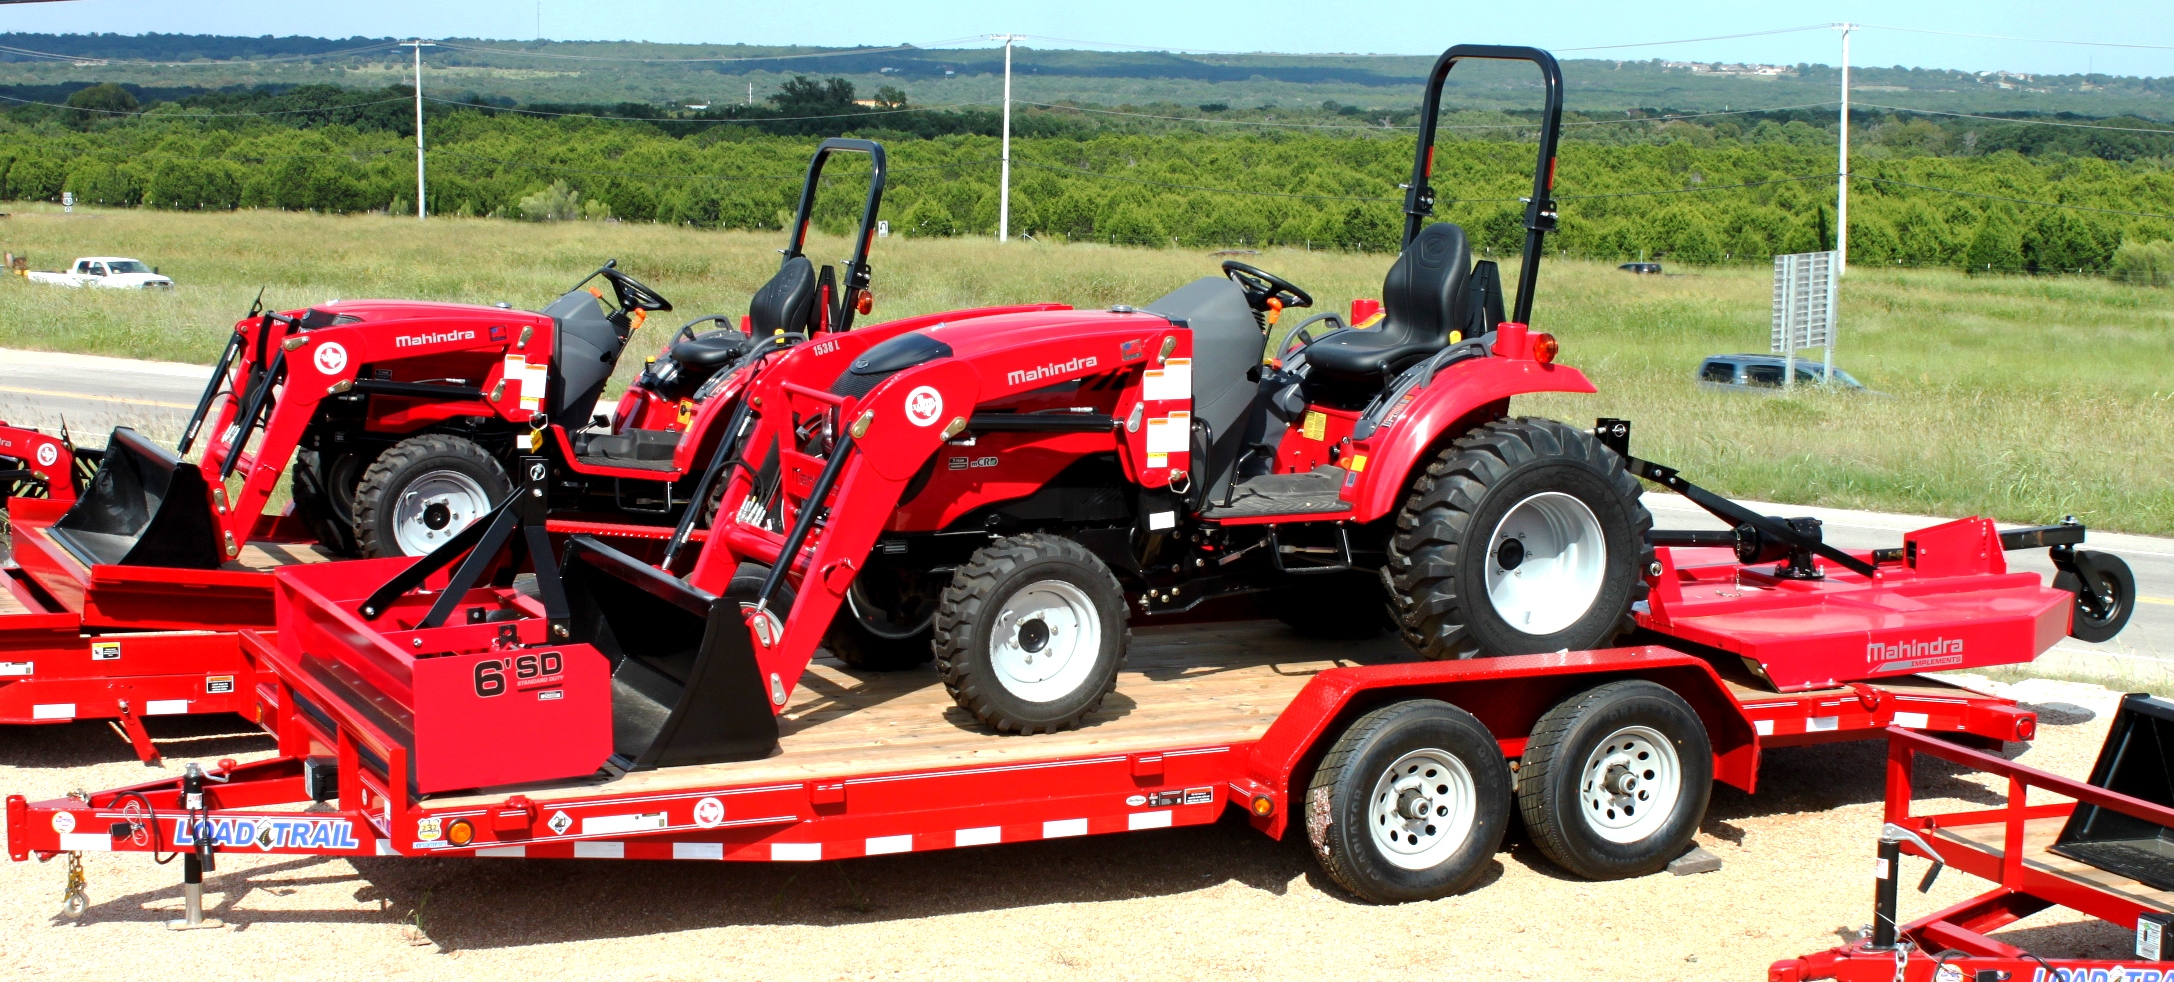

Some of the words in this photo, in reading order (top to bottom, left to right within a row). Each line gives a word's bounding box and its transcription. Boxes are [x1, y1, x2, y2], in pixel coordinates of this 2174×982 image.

[395, 329, 475, 348] Mahindra
[813, 341, 834, 357] 1538
[835, 339, 840, 351] L
[1007, 356, 1098, 386] Mahindra
[1867, 636, 1963, 663] Mahindra
[516, 651, 563, 679] SD
[1911, 655, 1961, 668] IMPLEMENTS
[517, 677, 548, 687] STANDARD
[174, 819, 256, 847] LOAD
[270, 821, 359, 849] TRAIL
